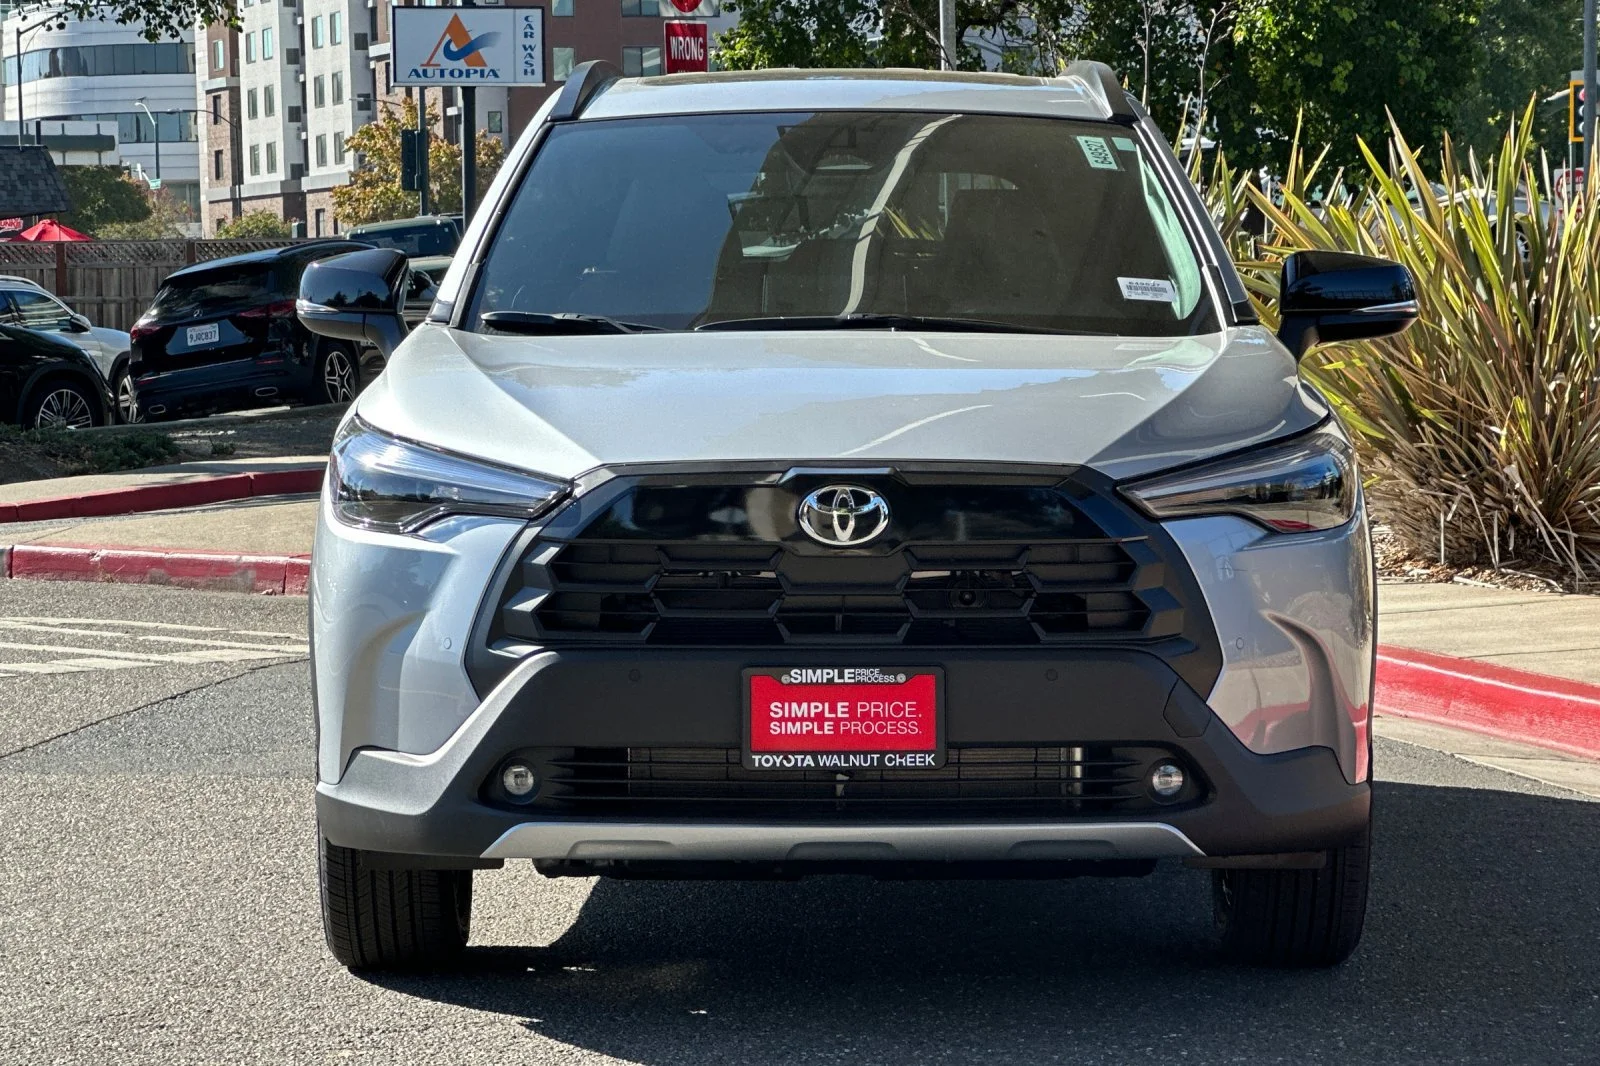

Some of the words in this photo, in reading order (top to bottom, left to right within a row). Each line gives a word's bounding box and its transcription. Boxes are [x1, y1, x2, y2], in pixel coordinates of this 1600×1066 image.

[523, 15, 535, 39] CAR
[669, 36, 704, 61] WRONG
[521, 44, 537, 76] WASH
[408, 68, 500, 79] AUTOPIA
[1084, 139, 1113, 165] 649527
[790, 668, 855, 683] SIMPLE
[769, 701, 850, 718] SIMPLE
[856, 701, 923, 718] PRICE.
[769, 721, 835, 735] SIMPLE
[839, 721, 923, 735] PROCESS.
[752, 755, 815, 768] TOYOTA
[817, 754, 880, 767] WALNUT
[884, 753, 936, 767] CREEK
